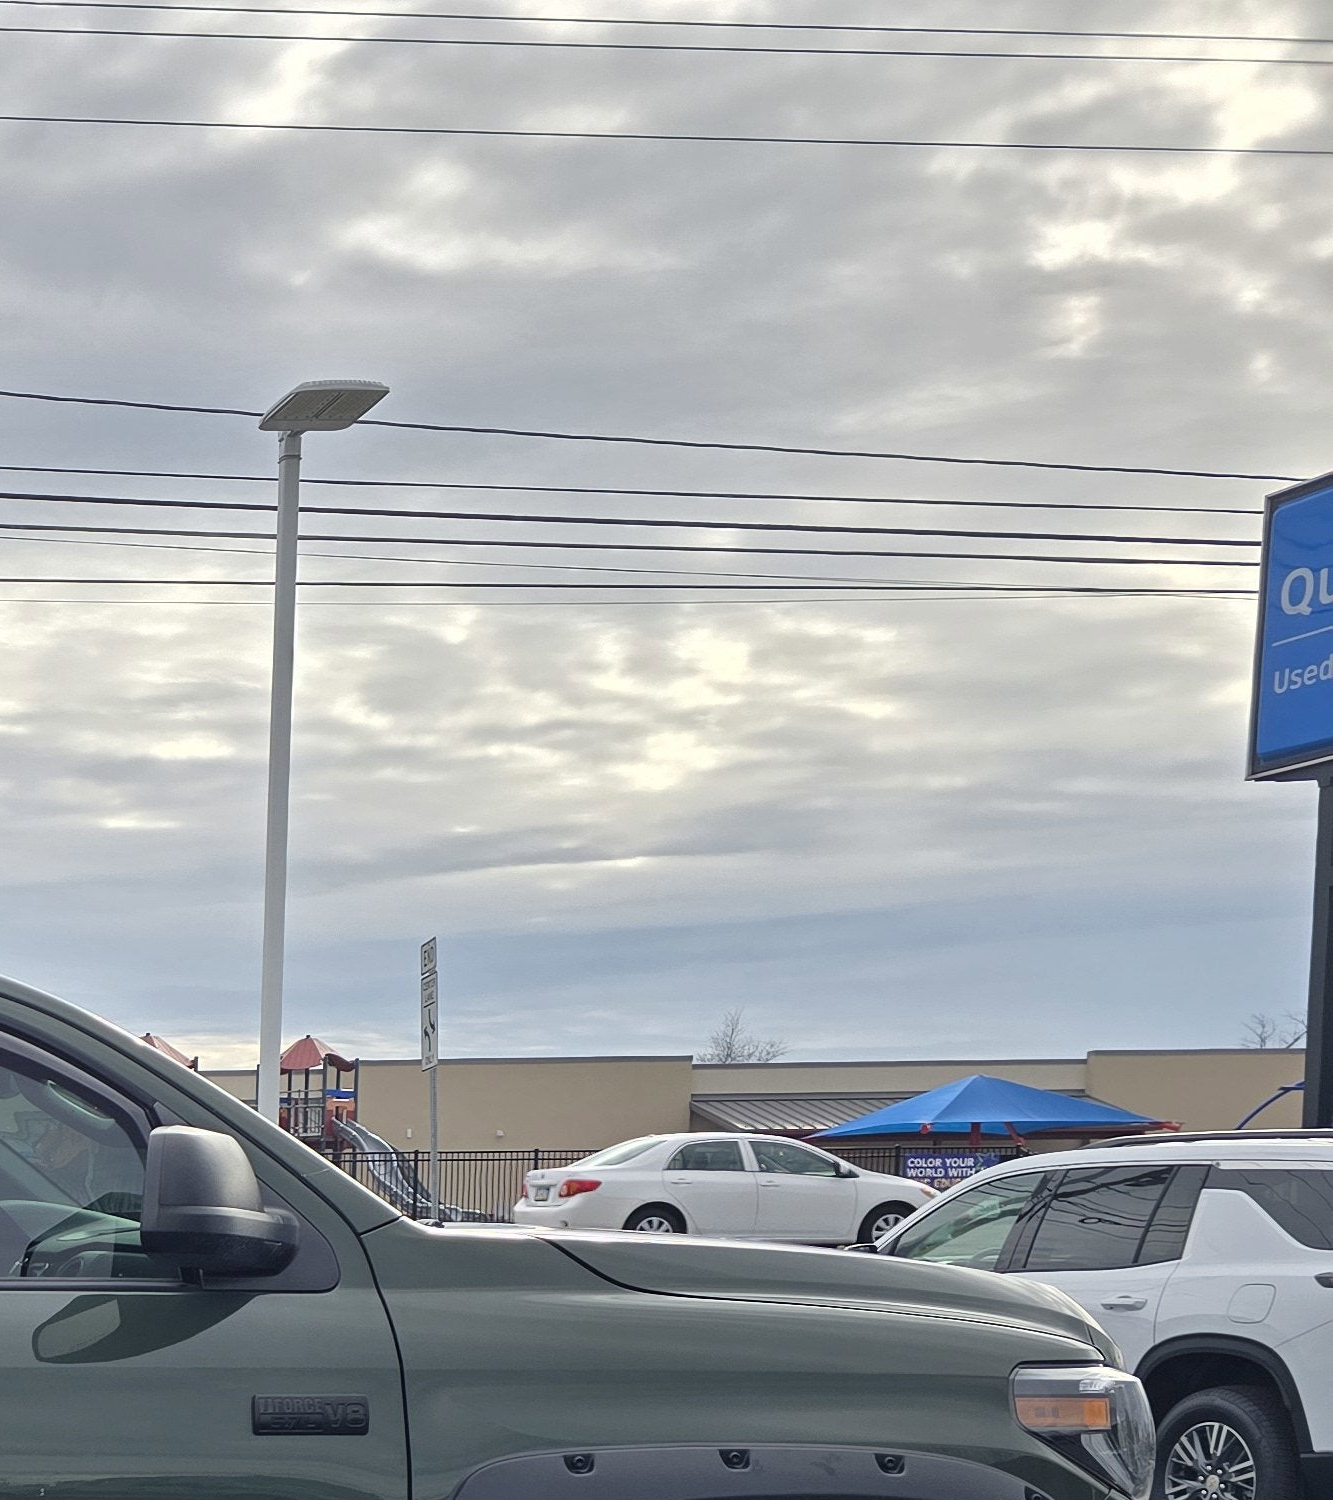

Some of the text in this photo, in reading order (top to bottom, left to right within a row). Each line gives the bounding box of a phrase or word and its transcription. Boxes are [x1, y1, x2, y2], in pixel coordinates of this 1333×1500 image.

[1273, 654, 1333, 694] Used
[907, 1158, 975, 1167] COLOR YOUR
[906, 1168, 975, 1177] WORLD WITH
[324, 1402, 367, 1428] V8
